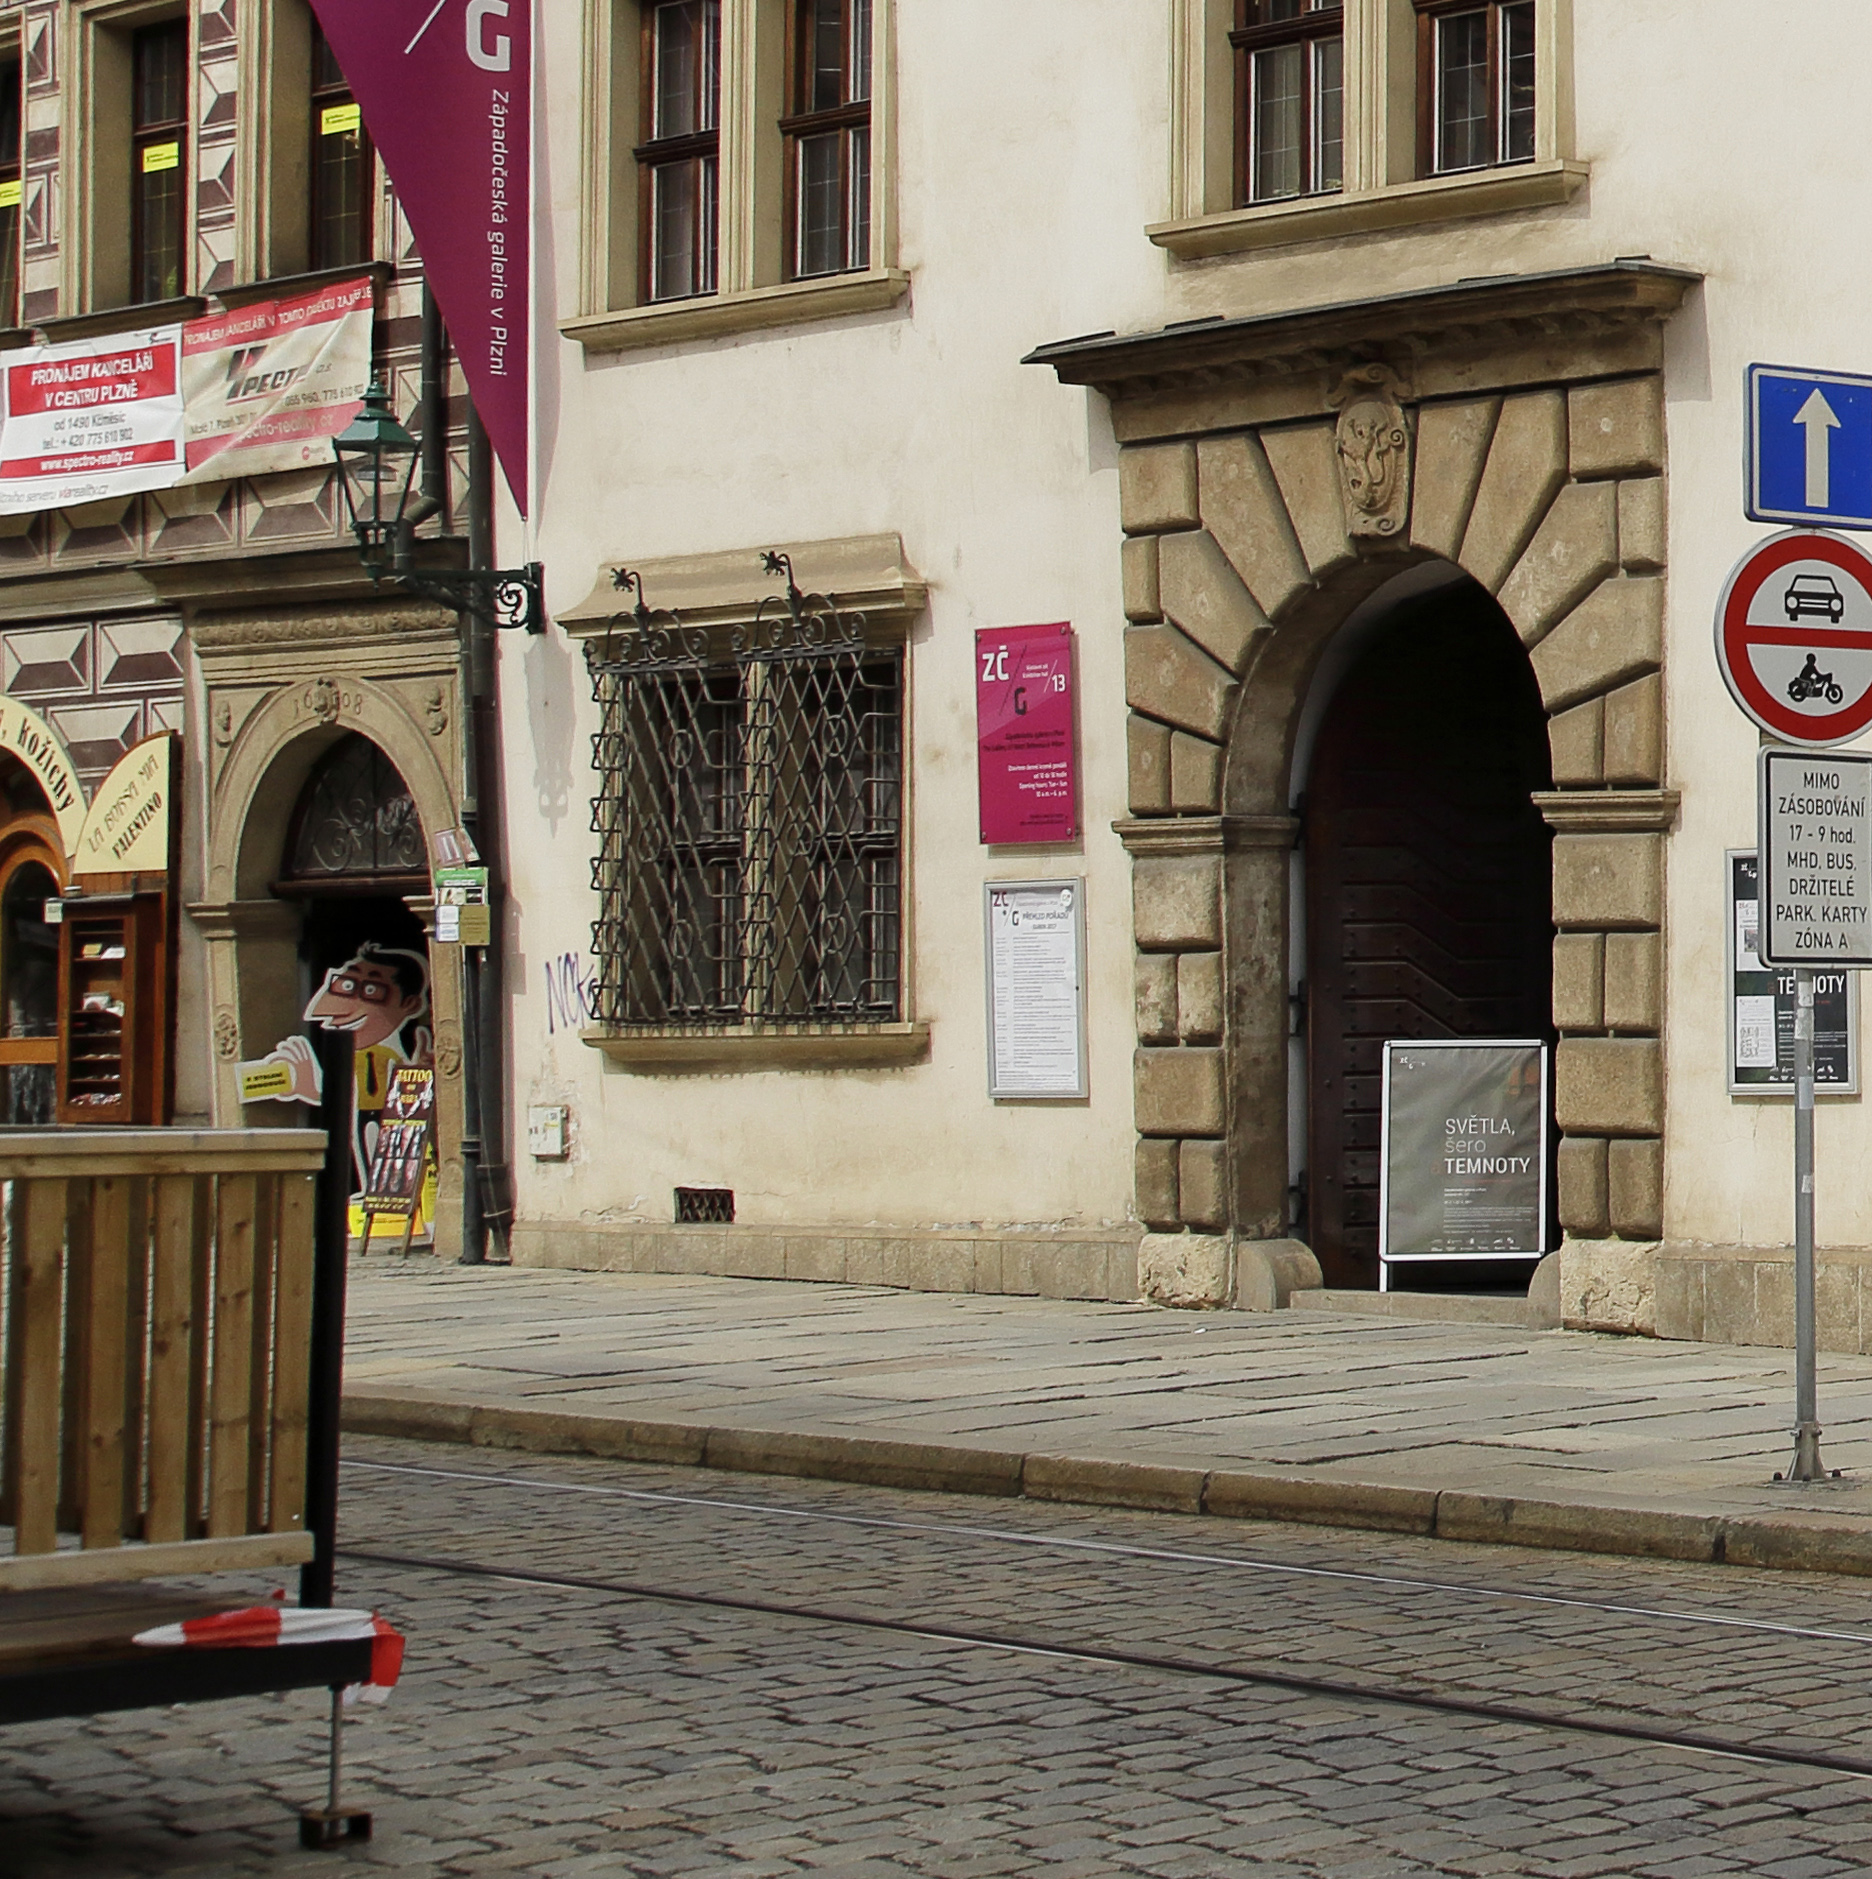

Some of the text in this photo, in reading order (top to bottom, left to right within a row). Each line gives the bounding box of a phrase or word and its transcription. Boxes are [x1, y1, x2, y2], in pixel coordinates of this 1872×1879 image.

[487, 88, 511, 377] Západočeská galerie v Plzni
[31, 351, 154, 386] PRONÁJEM KANCELÁŘÍ
[45, 379, 139, 408] V CENTRU PLZNĚ
[982, 644, 1010, 682] ZČ
[1051, 673, 1066, 692] 13
[1014, 687, 1027, 716] G
[1803, 772, 1840, 790] MIMO
[1778, 792, 1866, 817] ZÁSOBOVÁNÍ
[112, 791, 162, 860] VALENTINO
[1789, 824, 1803, 842] 17
[1818, 825, 1827, 843] 9
[1830, 827, 1856, 844] hod.
[1789, 874, 1855, 897] DRŽITELÉ
[1776, 904, 1817, 922] PARK.
[1822, 906, 1868, 924] KARTY
[1795, 927, 1849, 949] ZÓNA A
[1777, 973, 1846, 996] TEOTY
[397, 1069, 433, 1082] TATTOO
[1445, 1114, 1516, 1136] SVĚTLA,
[1445, 1136, 1487, 1154] šero
[1444, 1156, 1531, 1175] TEMNOTY
